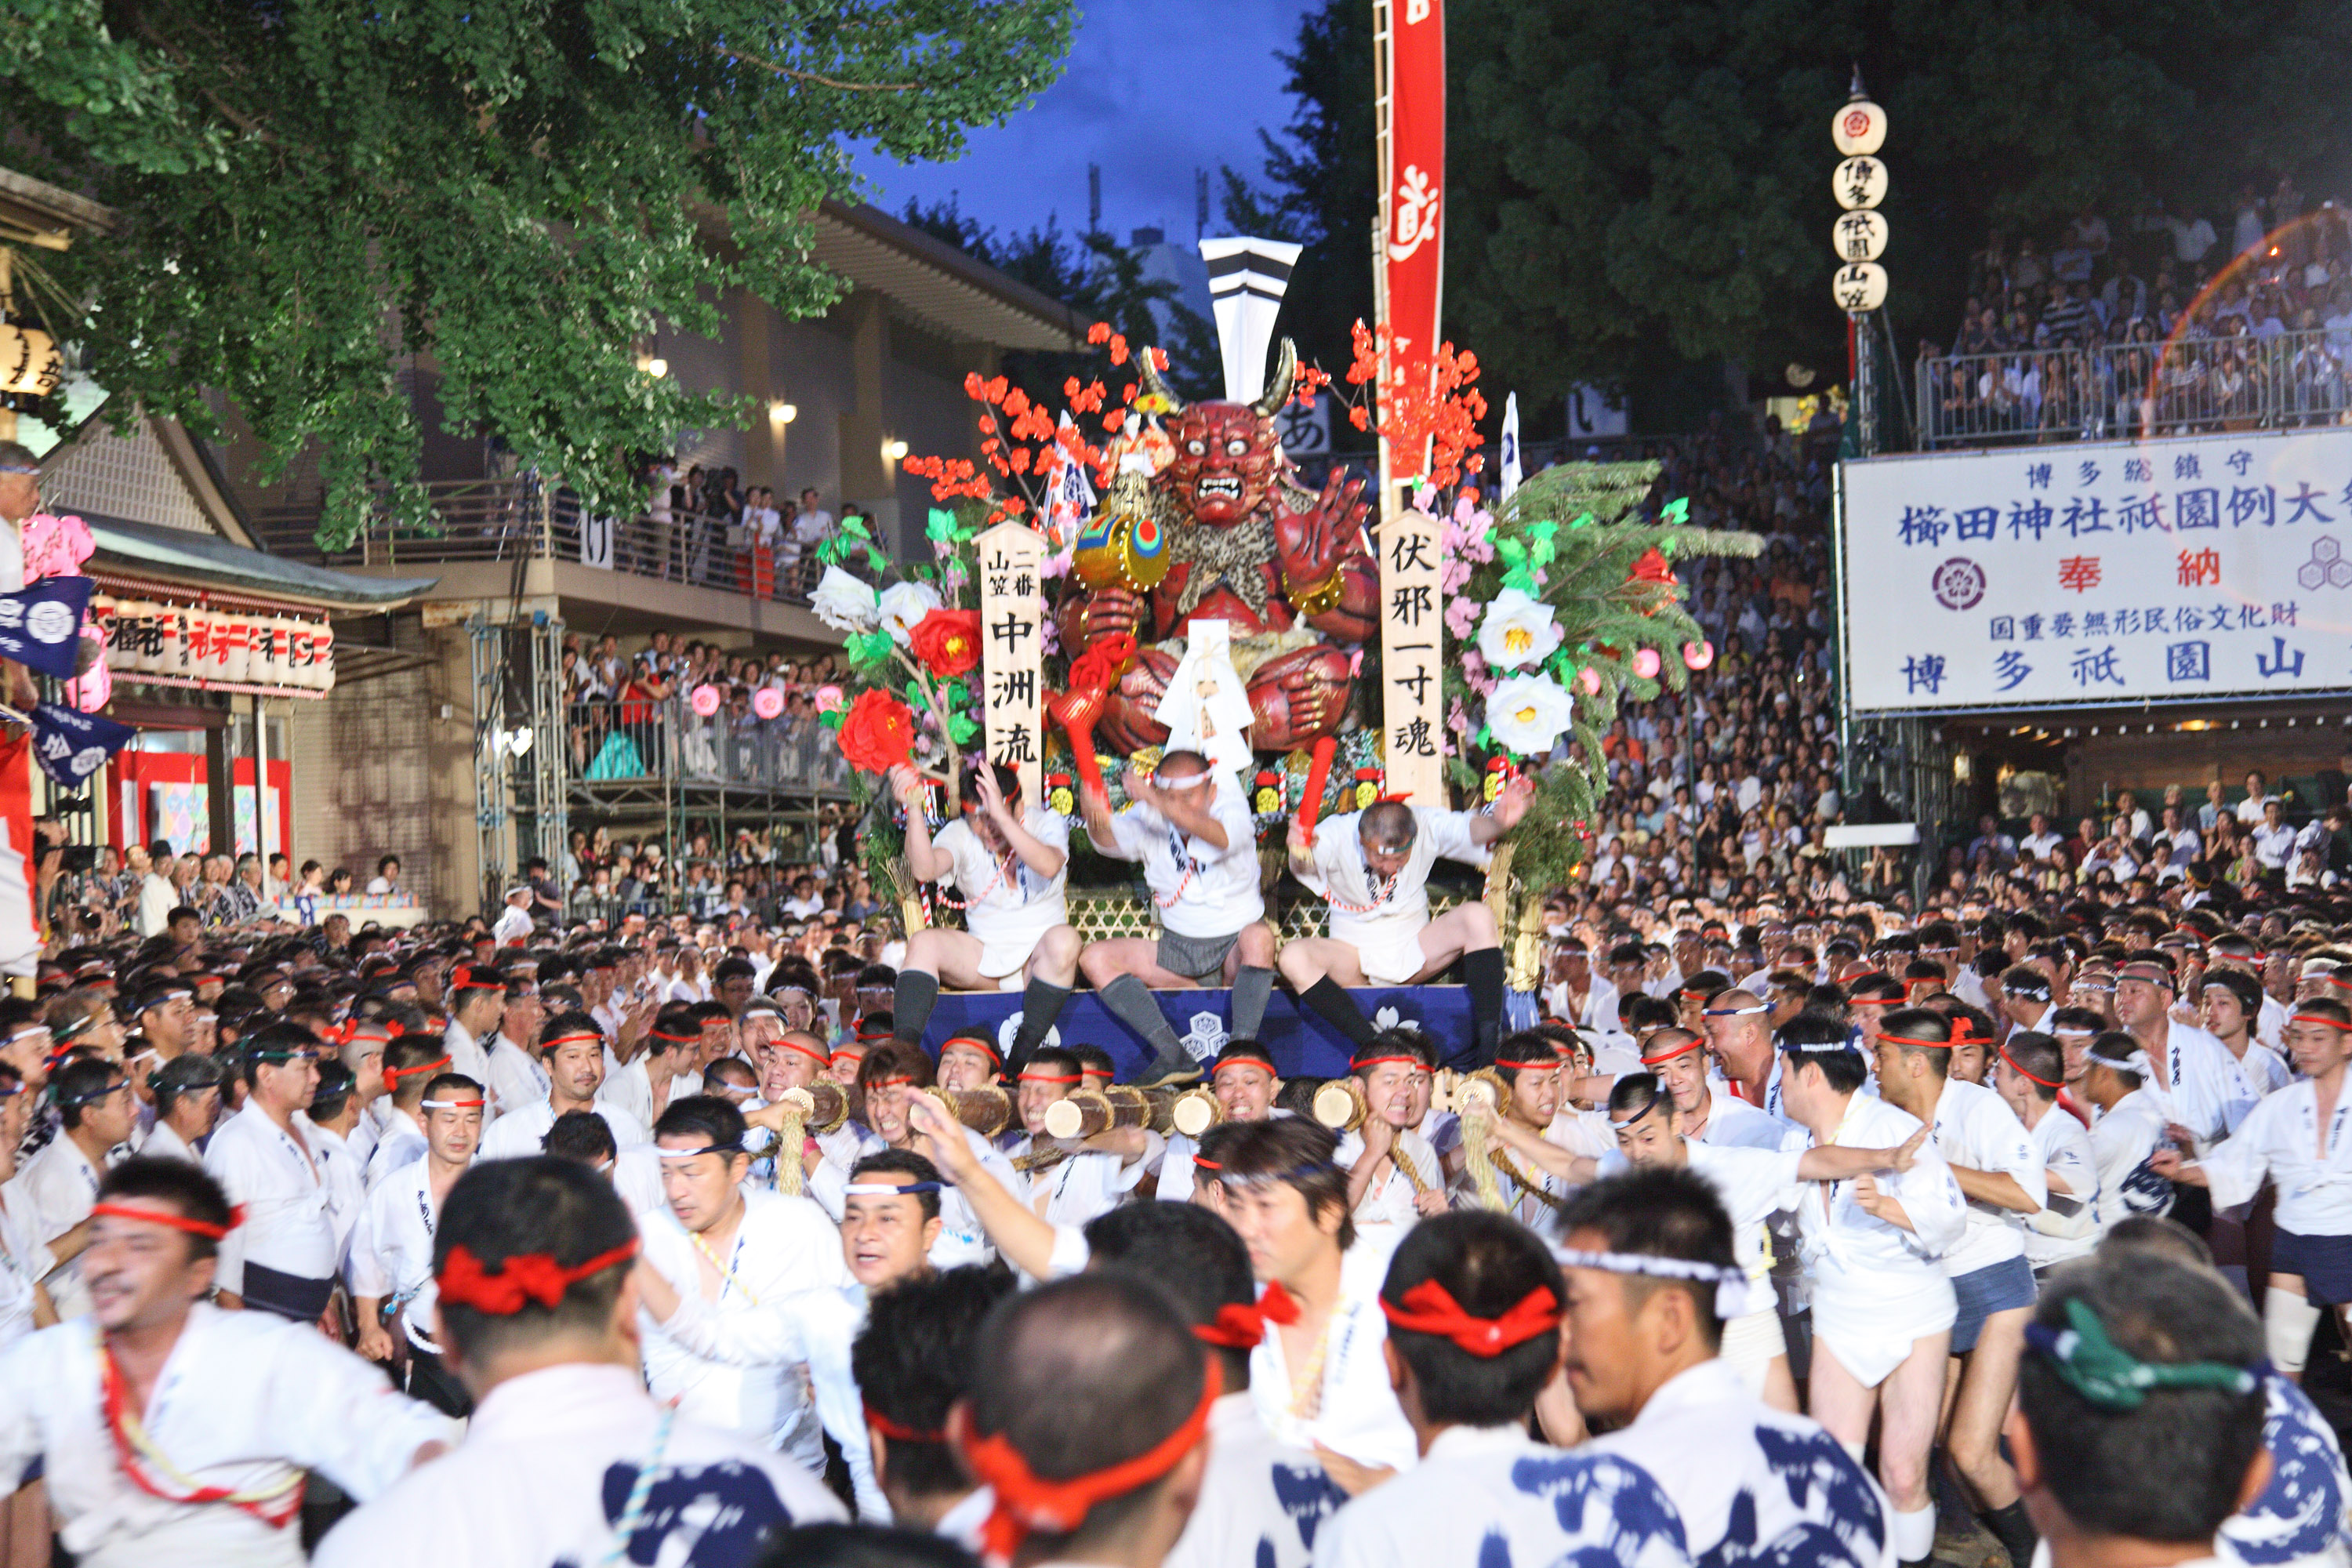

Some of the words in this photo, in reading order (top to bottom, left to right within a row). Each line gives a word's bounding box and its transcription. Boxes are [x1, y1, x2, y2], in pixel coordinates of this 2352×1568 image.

[1281, 400, 1324, 450] あ
[988, 550, 1010, 597] 山笠
[1012, 550, 1036, 597] 二番
[2058, 546, 2220, 594] 奉納
[1391, 533, 1437, 757] 伏邪一寸魂
[1990, 600, 2300, 642] 国重要無形民俗文化財
[991, 612, 1037, 765] 中洲流
[1900, 637, 2352, 695] 博多祇園山
